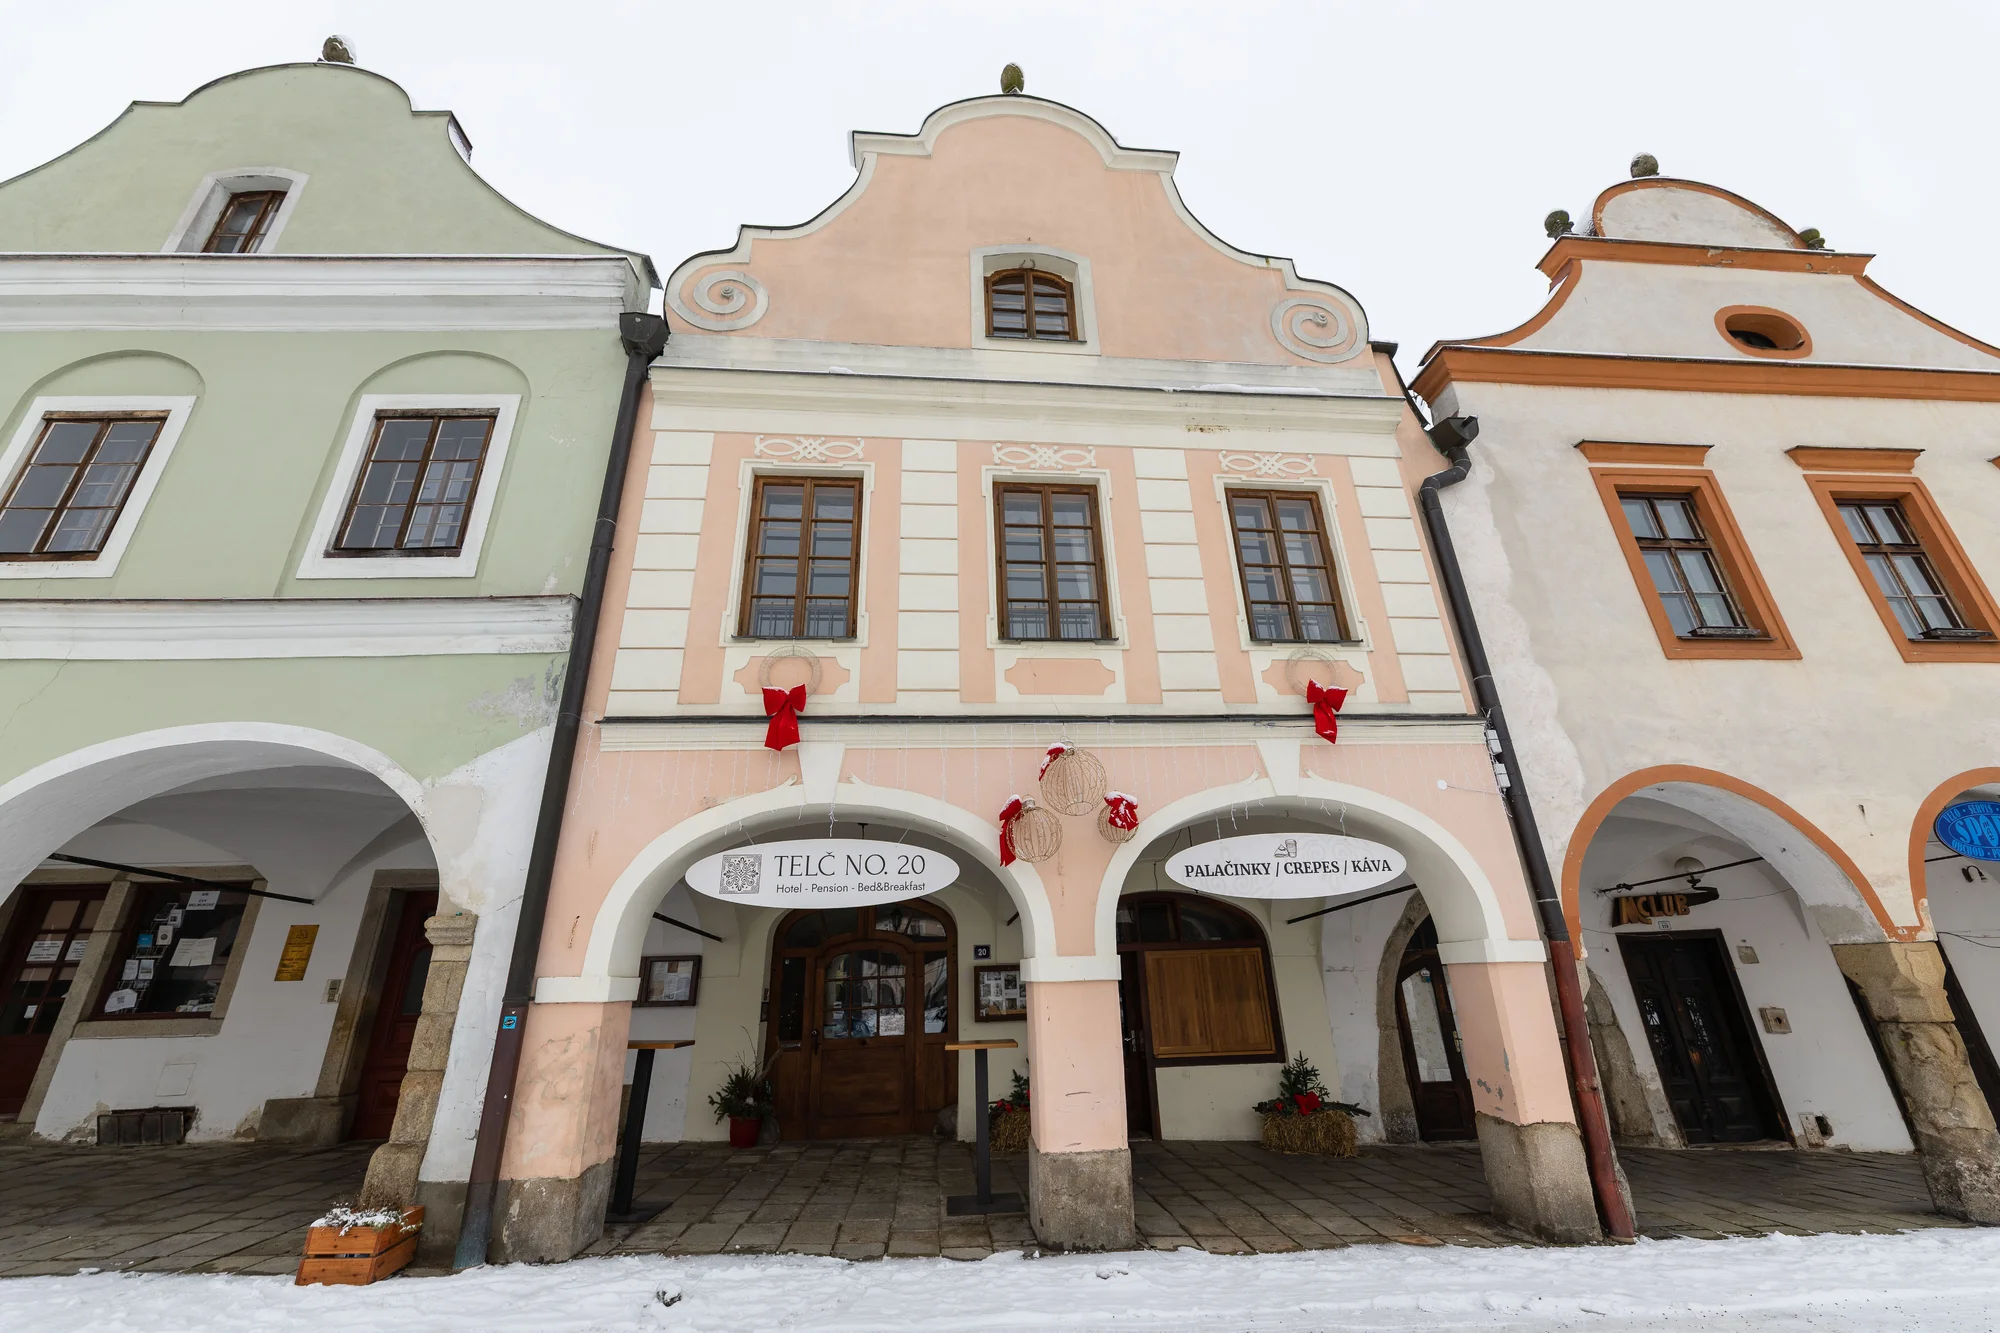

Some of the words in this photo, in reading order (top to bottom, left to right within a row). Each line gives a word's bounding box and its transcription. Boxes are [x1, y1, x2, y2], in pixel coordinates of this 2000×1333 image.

[1942, 808, 1960, 823] VELO
[1967, 804, 1993, 814] SERVIS
[1951, 840, 1984, 857] OBCHOD
[774, 851, 836, 877] TELČ
[845, 854, 888, 876] NO.
[897, 854, 926, 875] 20
[1184, 860, 1271, 878] PALAČINKY
[1283, 860, 1340, 875] CREPES
[1352, 857, 1393, 873] KÁVA
[776, 883, 802, 893] Hotel
[811, 883, 849, 893] Pension
[857, 881, 926, 892] Bed&Breakfast
[977, 948, 987, 957] 20
